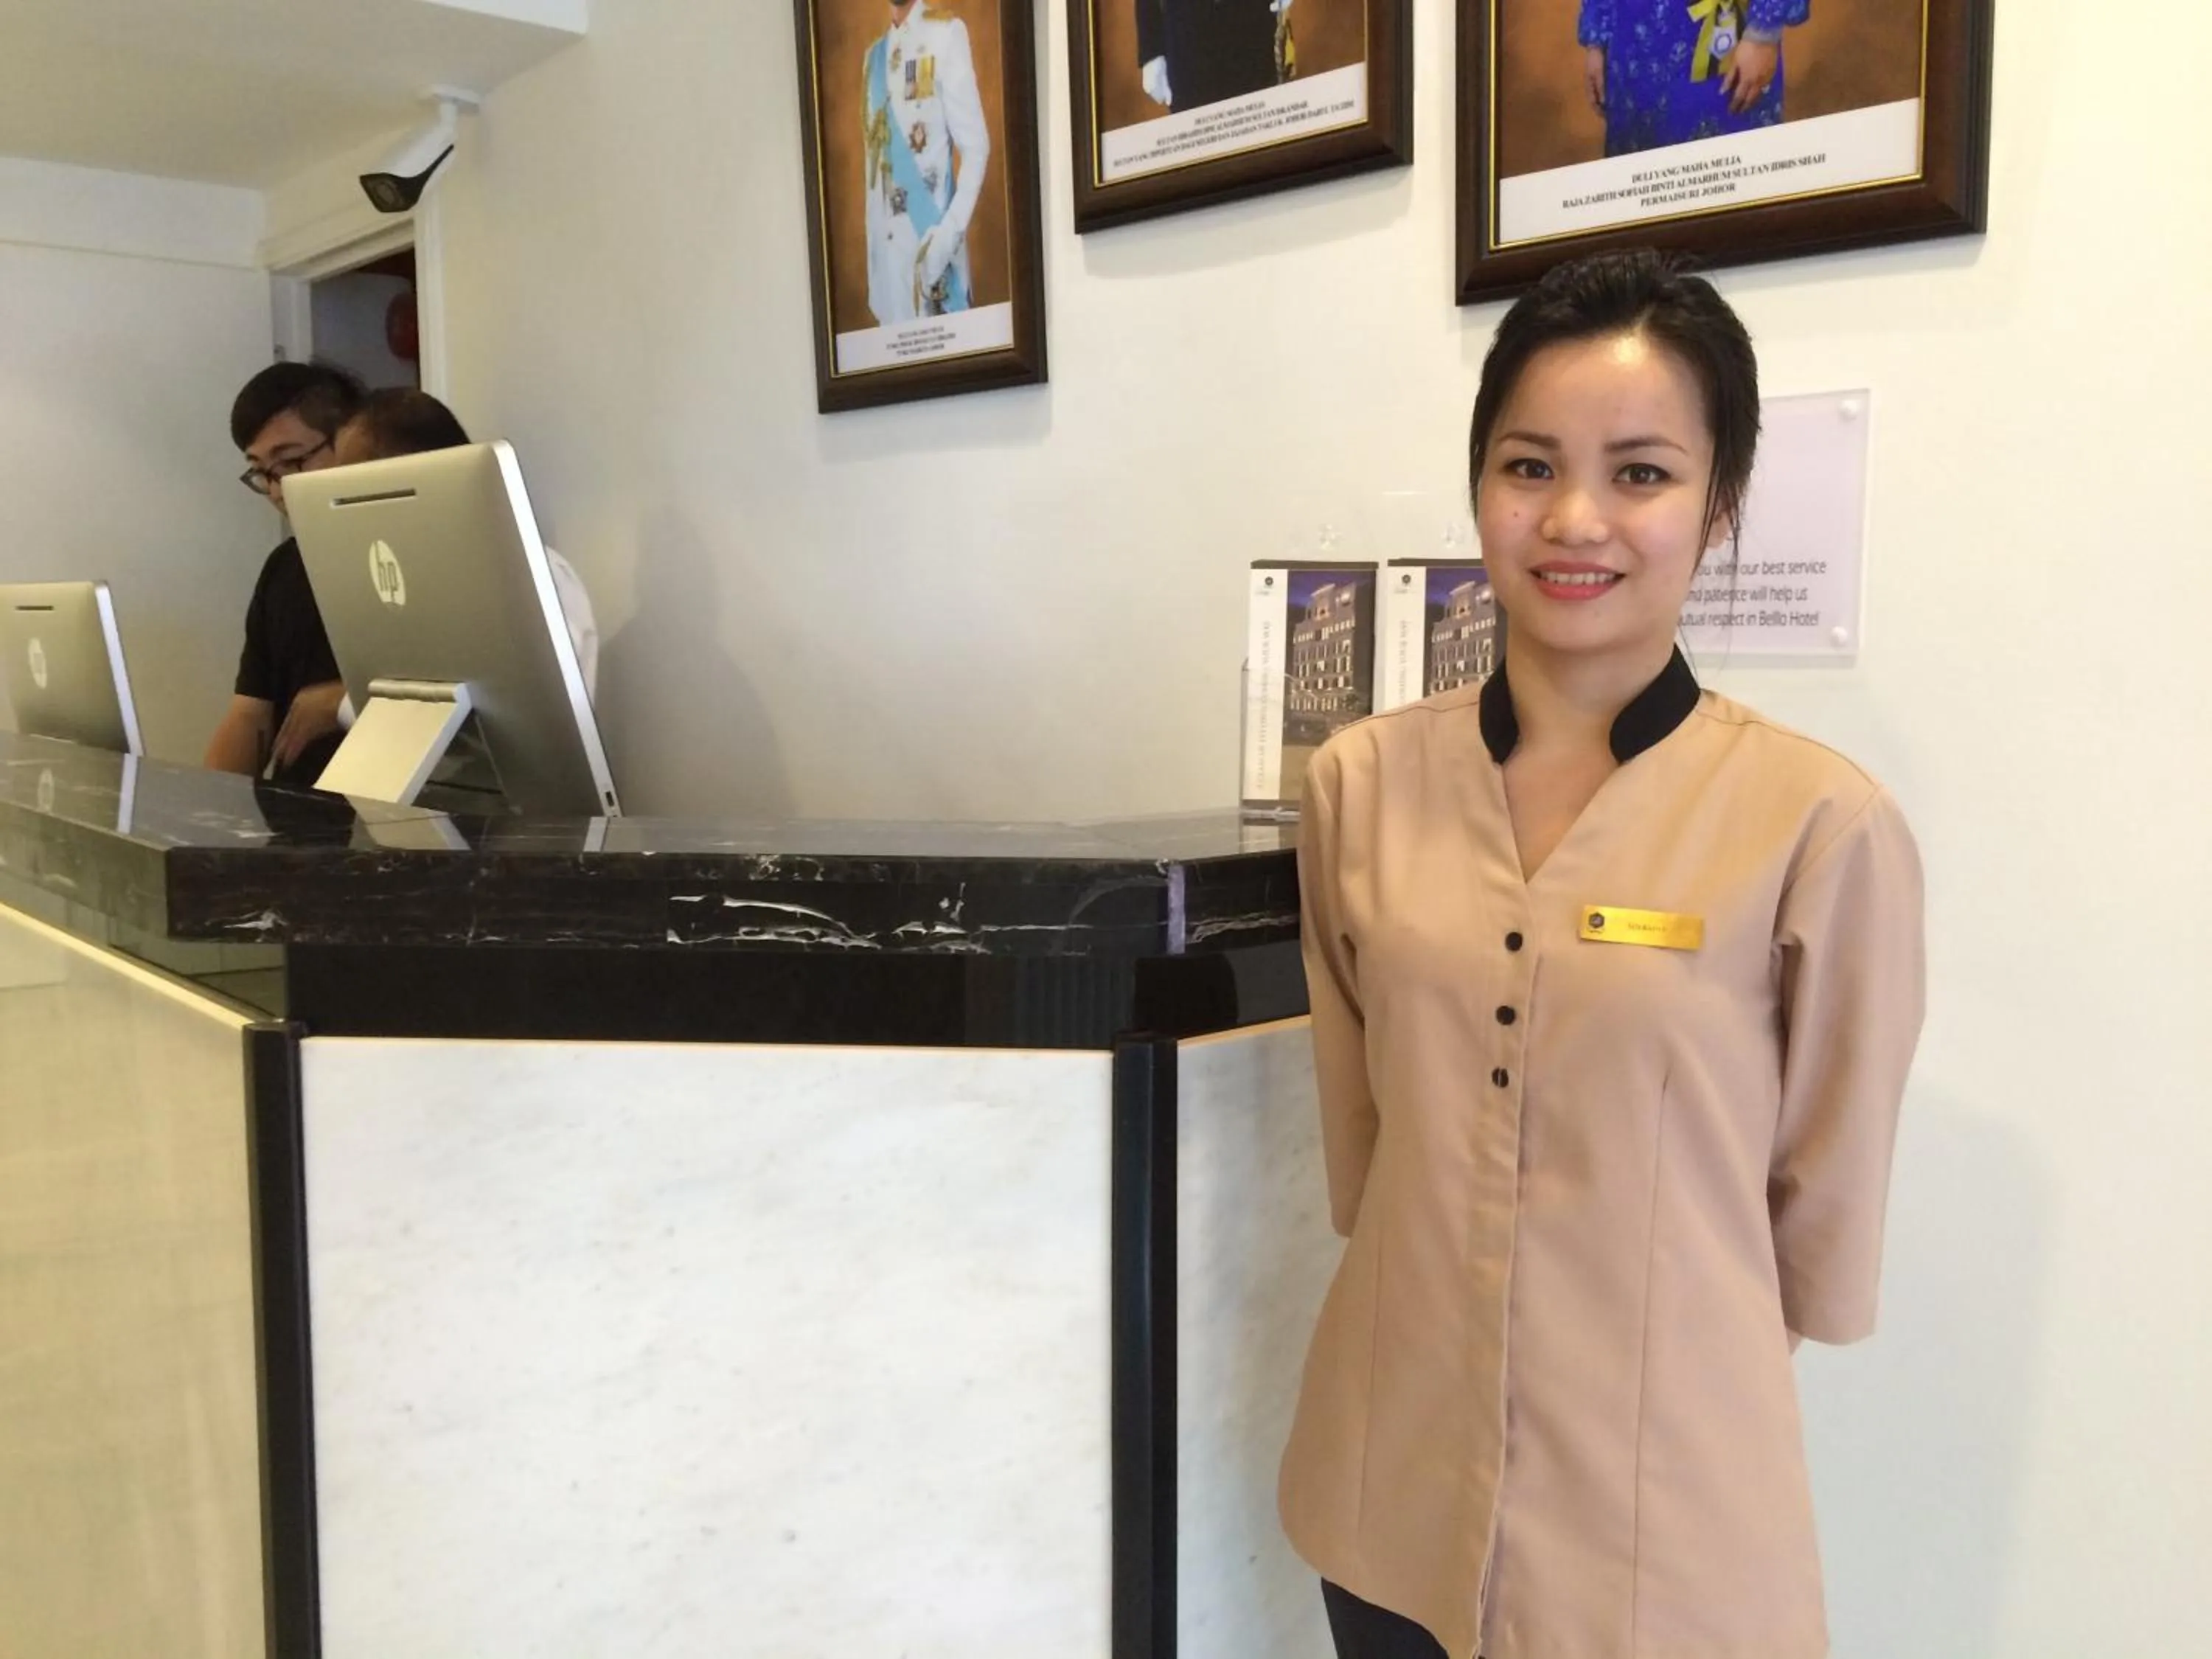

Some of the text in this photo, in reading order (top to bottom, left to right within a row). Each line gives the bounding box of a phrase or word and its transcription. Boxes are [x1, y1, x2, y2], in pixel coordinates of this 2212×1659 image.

[1562, 198, 1583, 209] RAJA
[1651, 180, 1674, 193] BINTI
[1733, 164, 1770, 178] SULTAN
[1798, 153, 1826, 165] SHAH
[1632, 155, 1741, 184] DULI YANG MAHA MULIA
[1641, 182, 1736, 207] PERMAISURI JOHOR
[374, 540, 399, 603] hp
[1740, 563, 1759, 575] our
[1761, 561, 1785, 574] best
[1788, 561, 1827, 574] service
[1704, 588, 1747, 605] patience
[1750, 585, 1767, 601] will
[1770, 586, 1792, 605] help
[1678, 612, 1706, 626] utual
[1708, 613, 1745, 630] respect
[1747, 611, 1757, 626] in
[1790, 611, 1820, 626] Hotel
